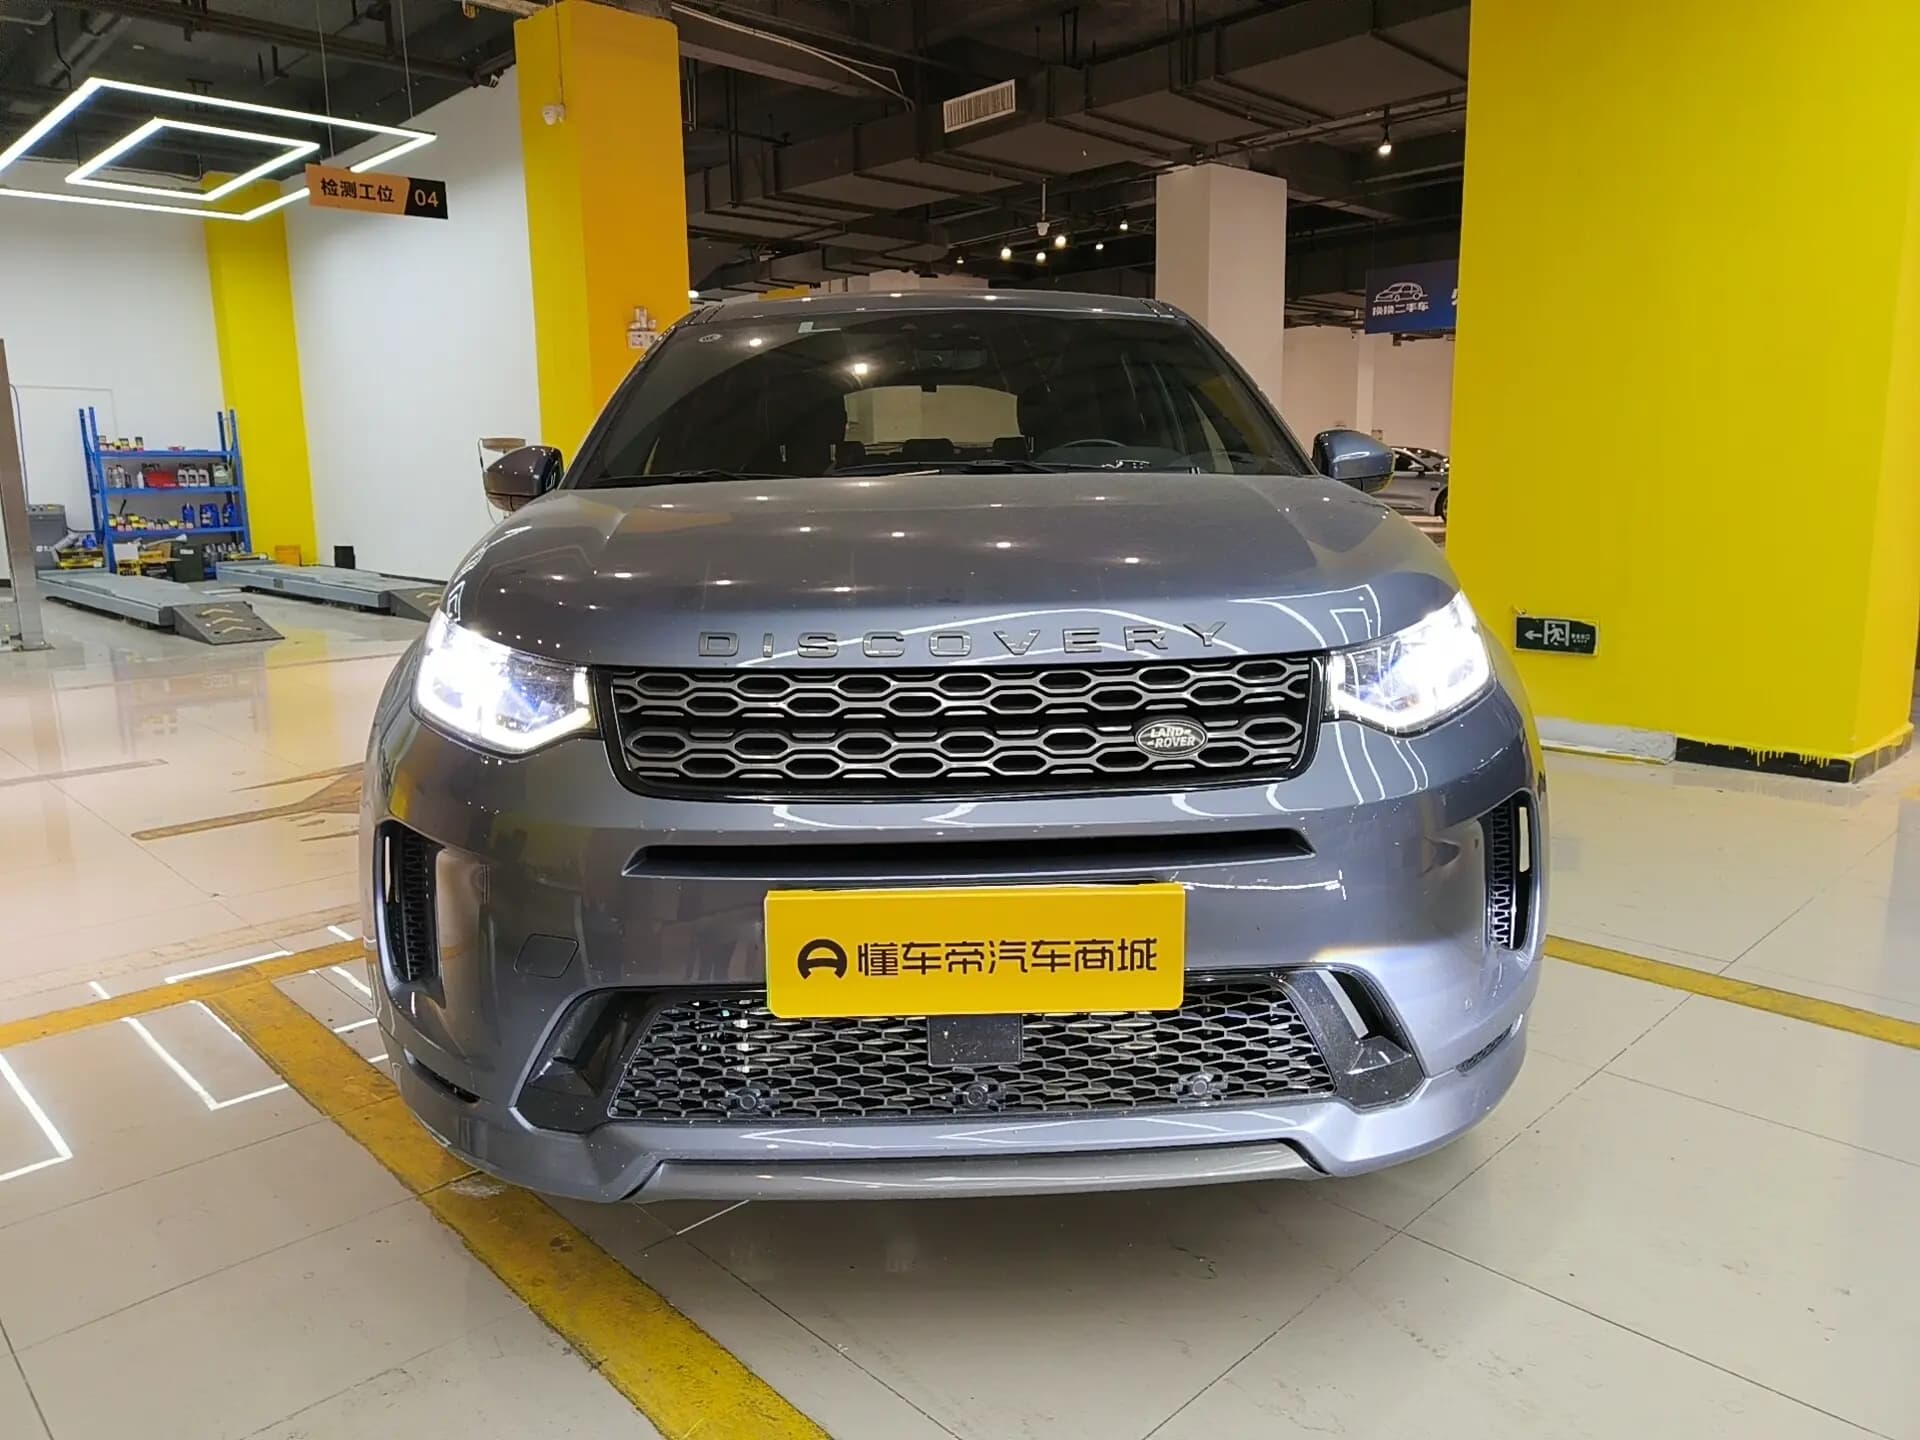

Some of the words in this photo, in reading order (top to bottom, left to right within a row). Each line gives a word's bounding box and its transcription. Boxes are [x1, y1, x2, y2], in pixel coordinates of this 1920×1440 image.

[320, 178, 394, 203] 检测工位
[415, 189, 439, 208] 04
[698, 621, 1226, 658] DISCOVERY
[857, 938, 1158, 977] 懂车帝汽车商城
